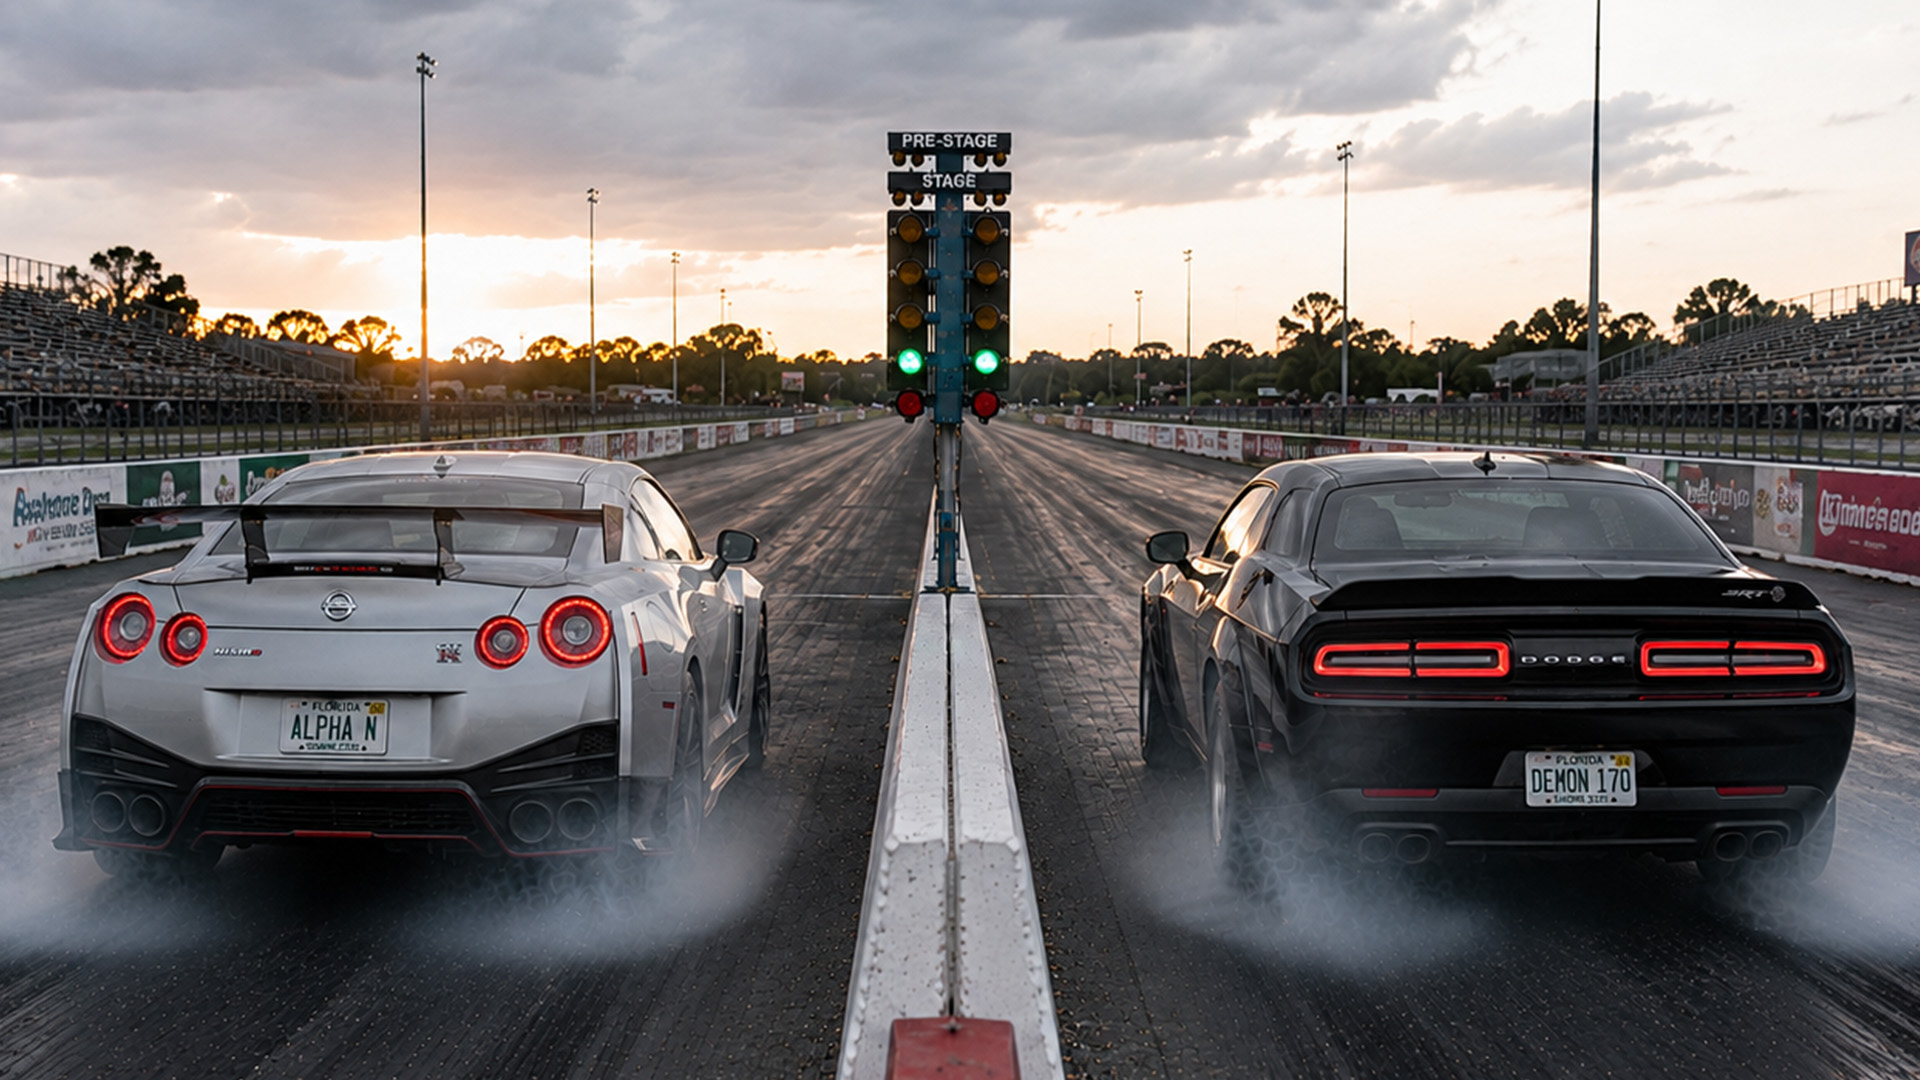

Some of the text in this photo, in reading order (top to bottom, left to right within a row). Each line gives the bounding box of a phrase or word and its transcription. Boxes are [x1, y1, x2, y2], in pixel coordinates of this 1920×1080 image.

[902, 133, 998, 148] PRE-STAGE
[922, 173, 977, 188] STAGE
[1521, 655, 1626, 664] DODGE
[290, 713, 377, 741] ALPHA N
[1531, 768, 1632, 793] DEMON 170
